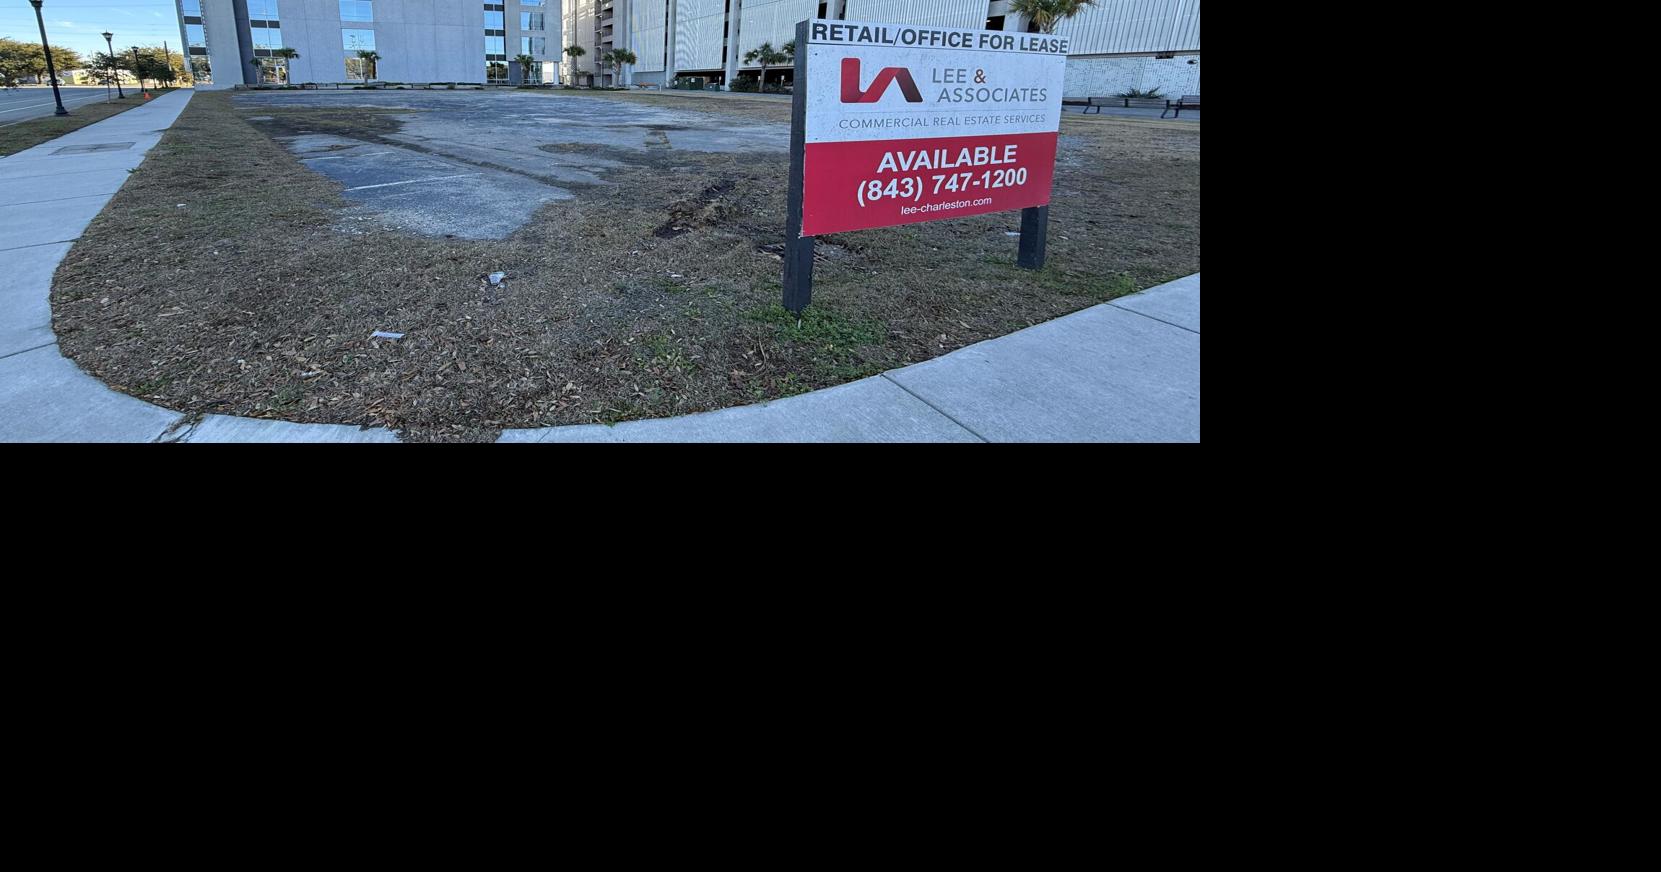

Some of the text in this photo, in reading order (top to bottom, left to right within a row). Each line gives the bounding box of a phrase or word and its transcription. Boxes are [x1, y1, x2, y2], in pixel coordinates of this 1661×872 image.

[812, 23, 1069, 54] RETAIL/OFFICE FOR LEASE
[932, 68, 987, 84] LEE &
[937, 87, 1048, 103] ASSOCIATES
[839, 113, 1046, 130] COMMERCIAL REAL ESTATE SERVICES
[877, 145, 1018, 173] AVAILABLE
[857, 167, 1028, 207] (843) 747-1200
[901, 196, 992, 215] lee-charleston.com
